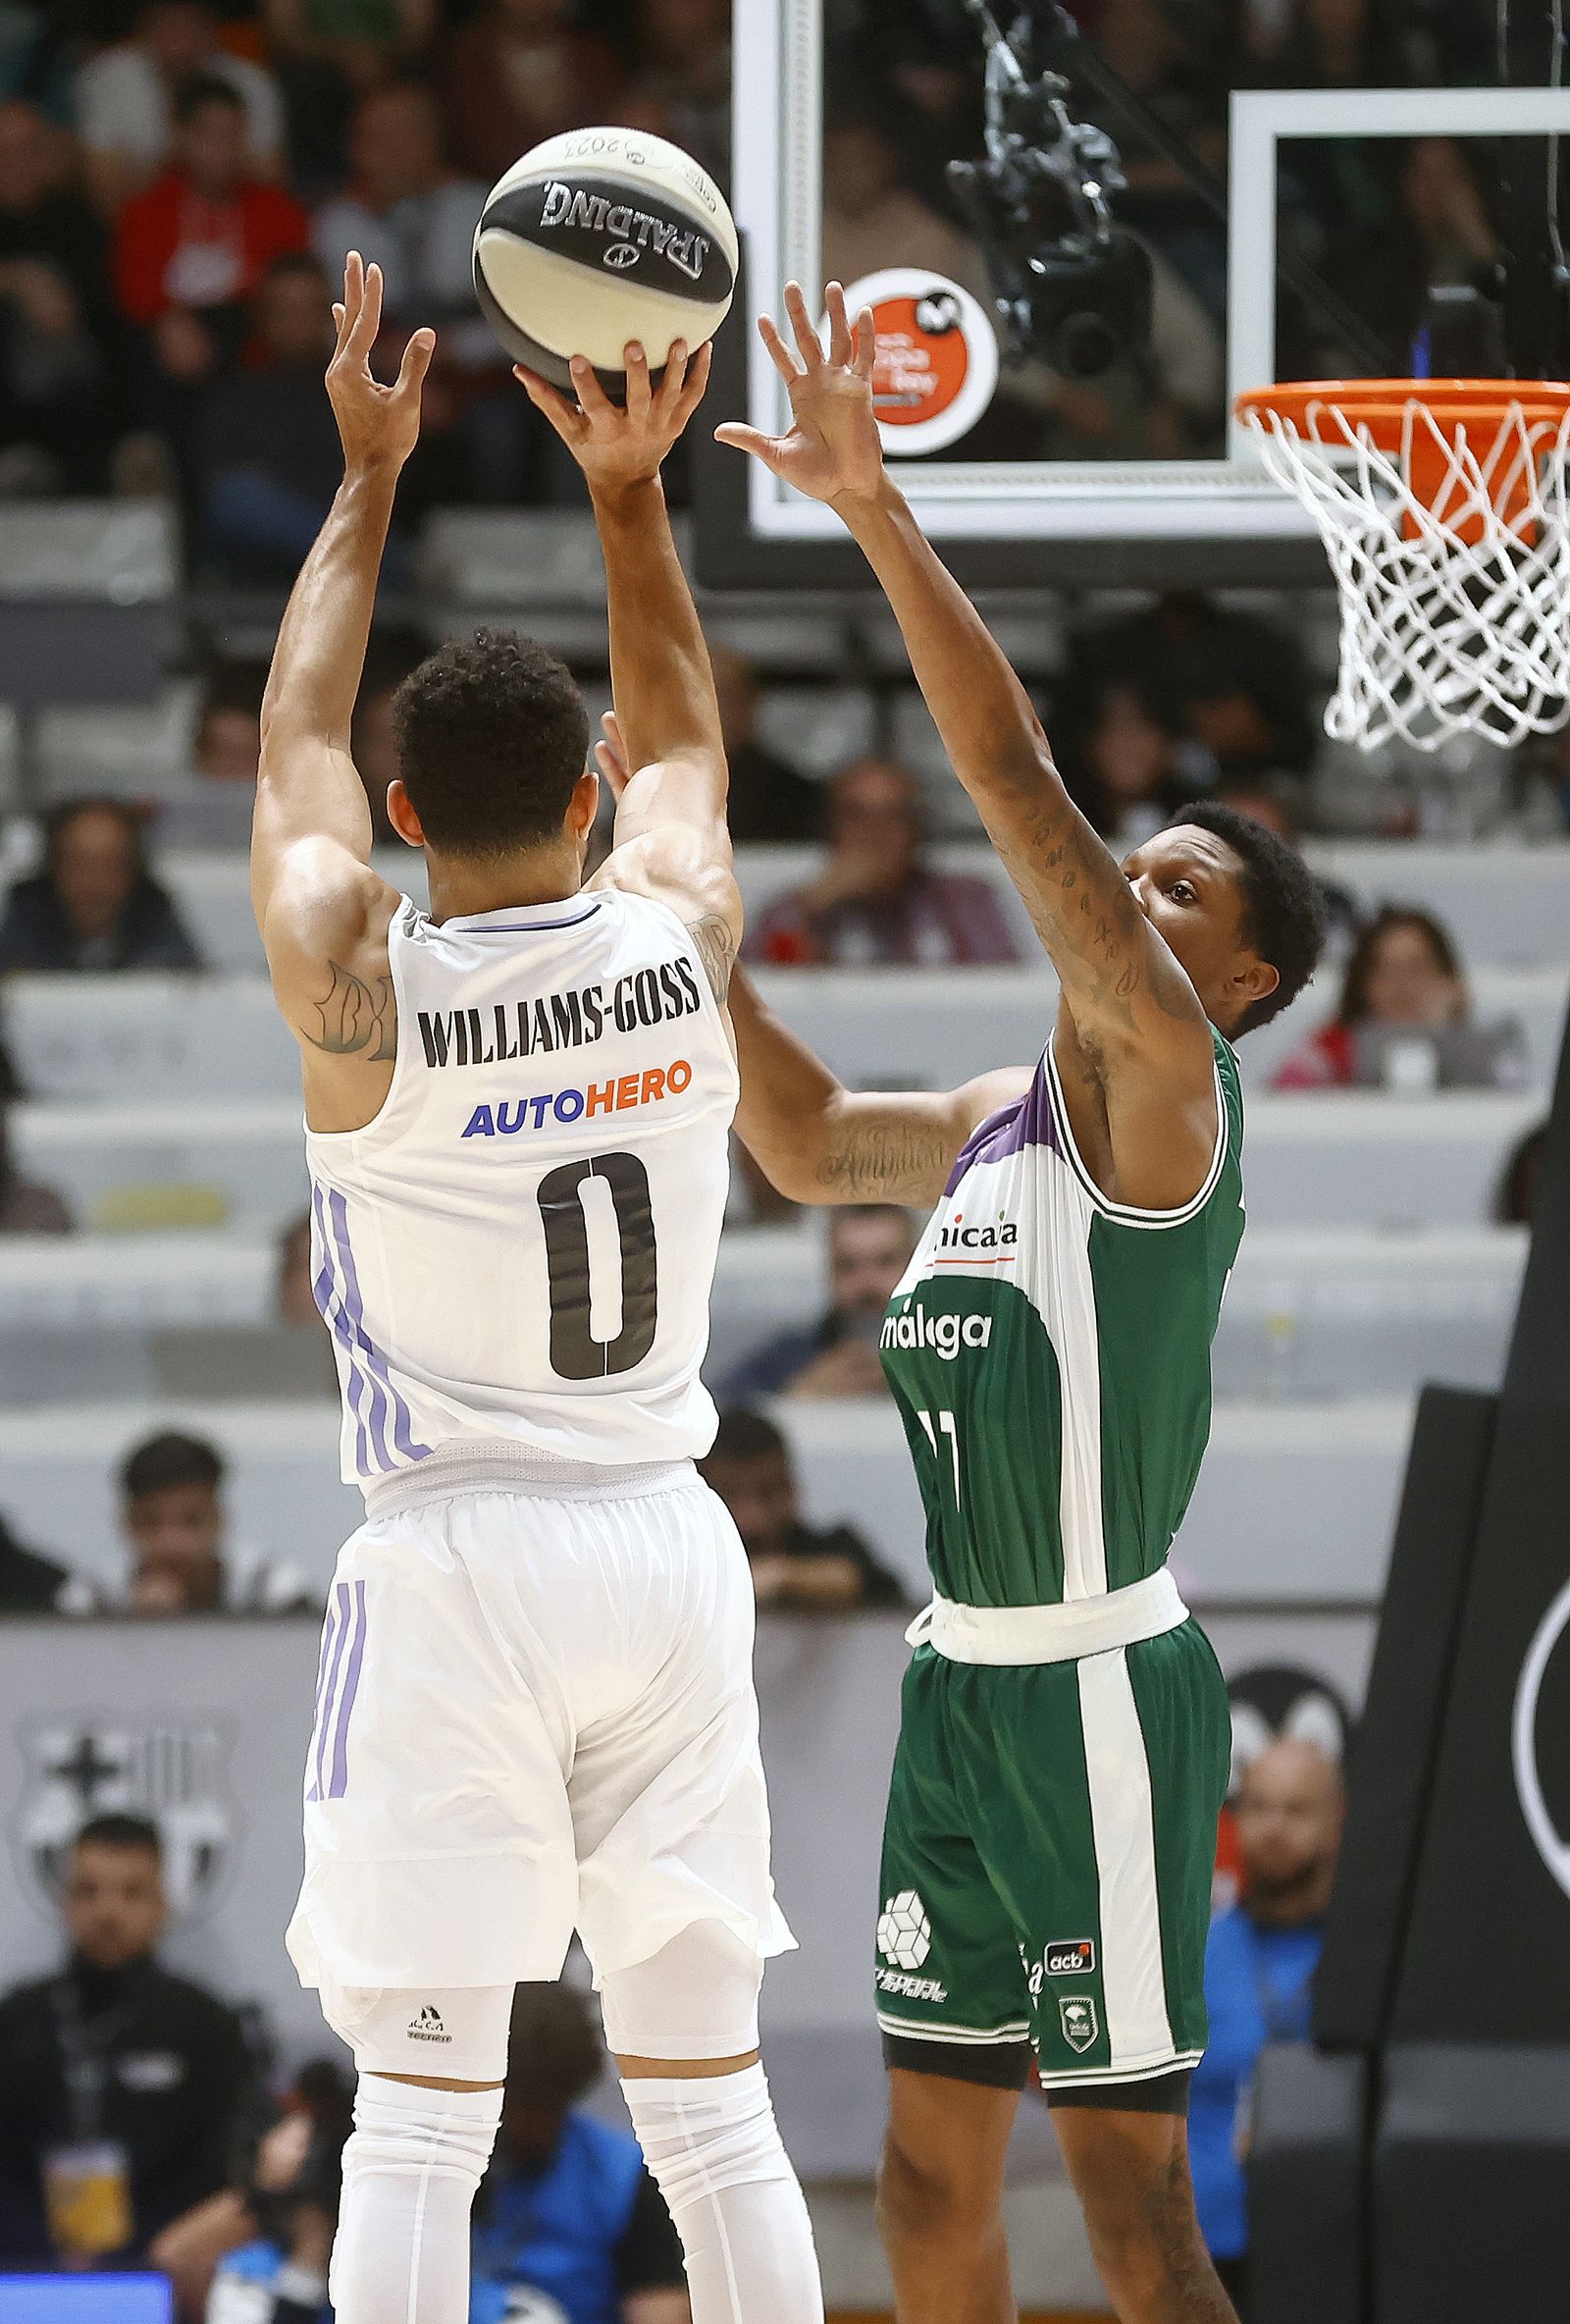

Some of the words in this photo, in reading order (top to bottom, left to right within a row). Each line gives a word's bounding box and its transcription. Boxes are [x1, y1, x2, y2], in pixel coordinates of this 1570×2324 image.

[540, 182, 710, 280] SPALDING
[417, 957, 701, 1068] WILLIAMS-GOSS
[461, 1060, 693, 1137] AUTOHERO
[537, 1151, 657, 1380] 0
[1050, 1951, 1084, 1971] acb
